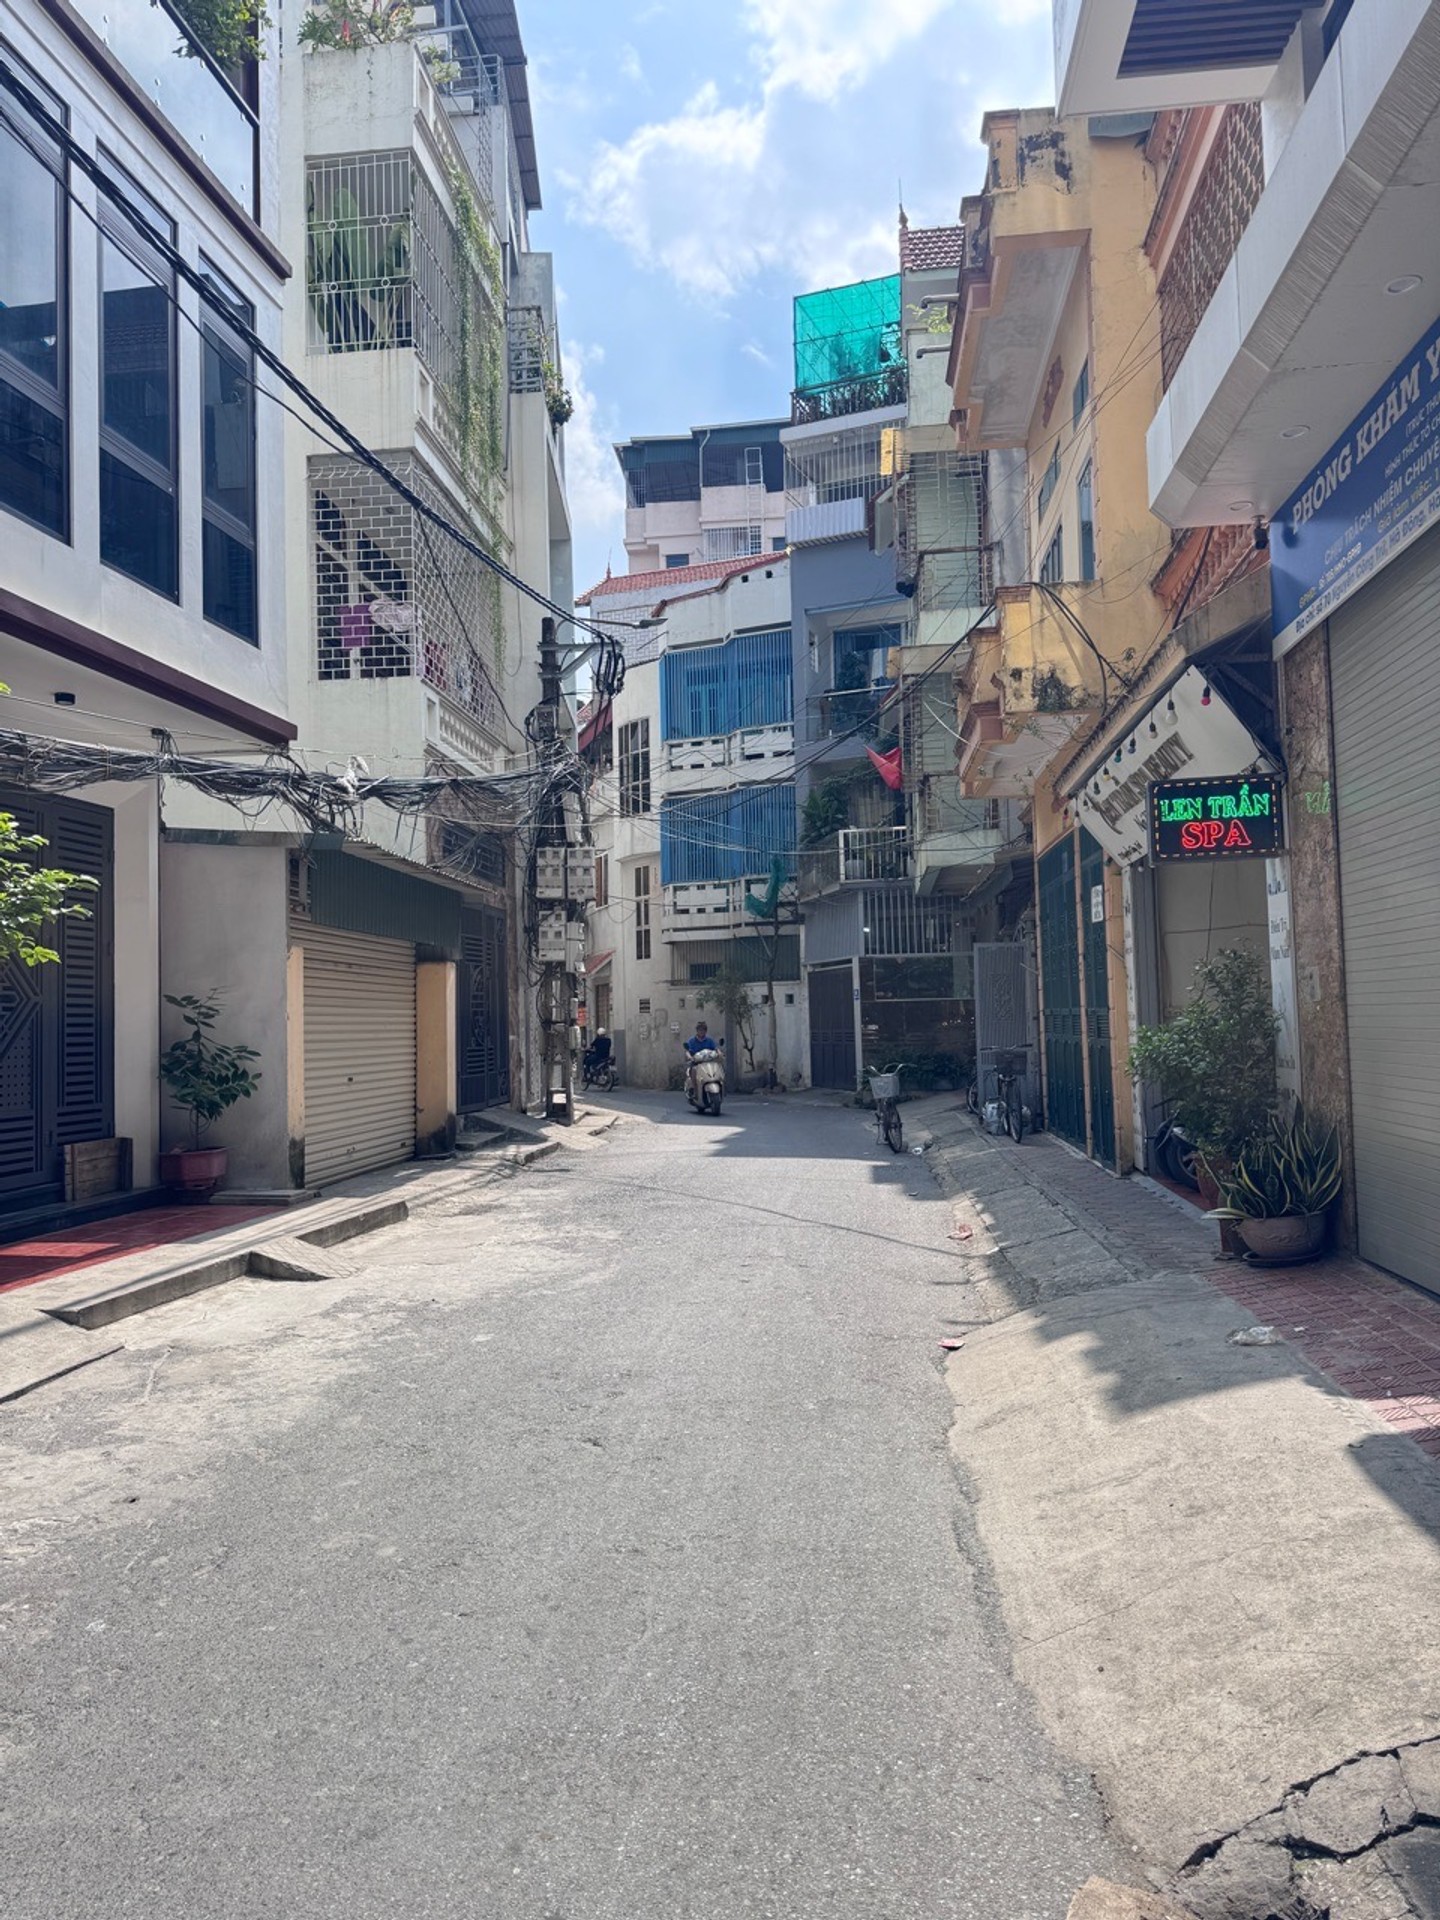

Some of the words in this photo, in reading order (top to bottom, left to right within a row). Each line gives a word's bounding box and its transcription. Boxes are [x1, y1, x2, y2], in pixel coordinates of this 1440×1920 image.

[1292, 440, 1351, 535] PHÒNG
[1356, 361, 1420, 464] KHÁM
[1345, 509, 1371, 544] TRÁCH
[1373, 476, 1401, 517] NHIỆM
[1160, 797, 1203, 822] LEN
[1208, 784, 1270, 819] TRẦN
[1182, 820, 1252, 849] SPA
